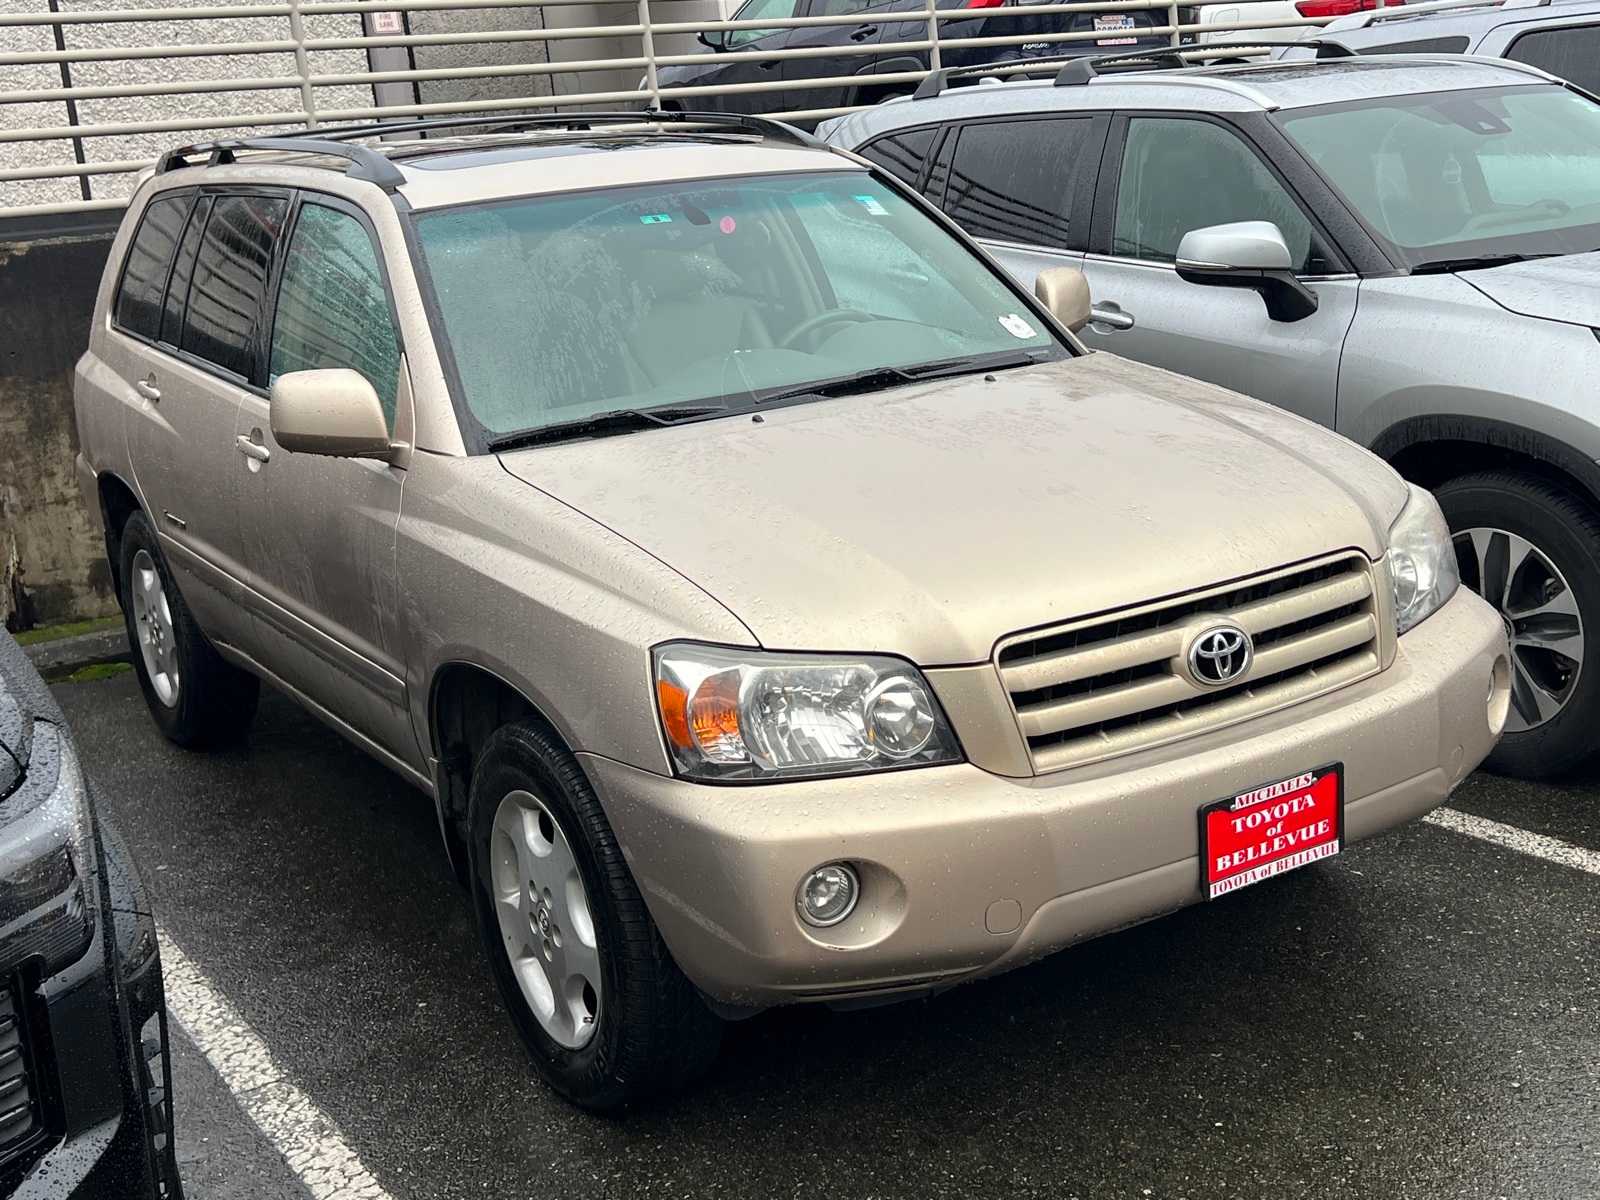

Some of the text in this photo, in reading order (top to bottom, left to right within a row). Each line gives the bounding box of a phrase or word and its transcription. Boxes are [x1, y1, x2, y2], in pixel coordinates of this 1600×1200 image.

[1237, 775, 1311, 807] MICHAELS
[1231, 794, 1316, 833] TOYOTA
[1266, 820, 1284, 837] of
[1216, 819, 1330, 872] BELLEVUE
[1212, 842, 1337, 896] TOYOTA of BELLEVUE
